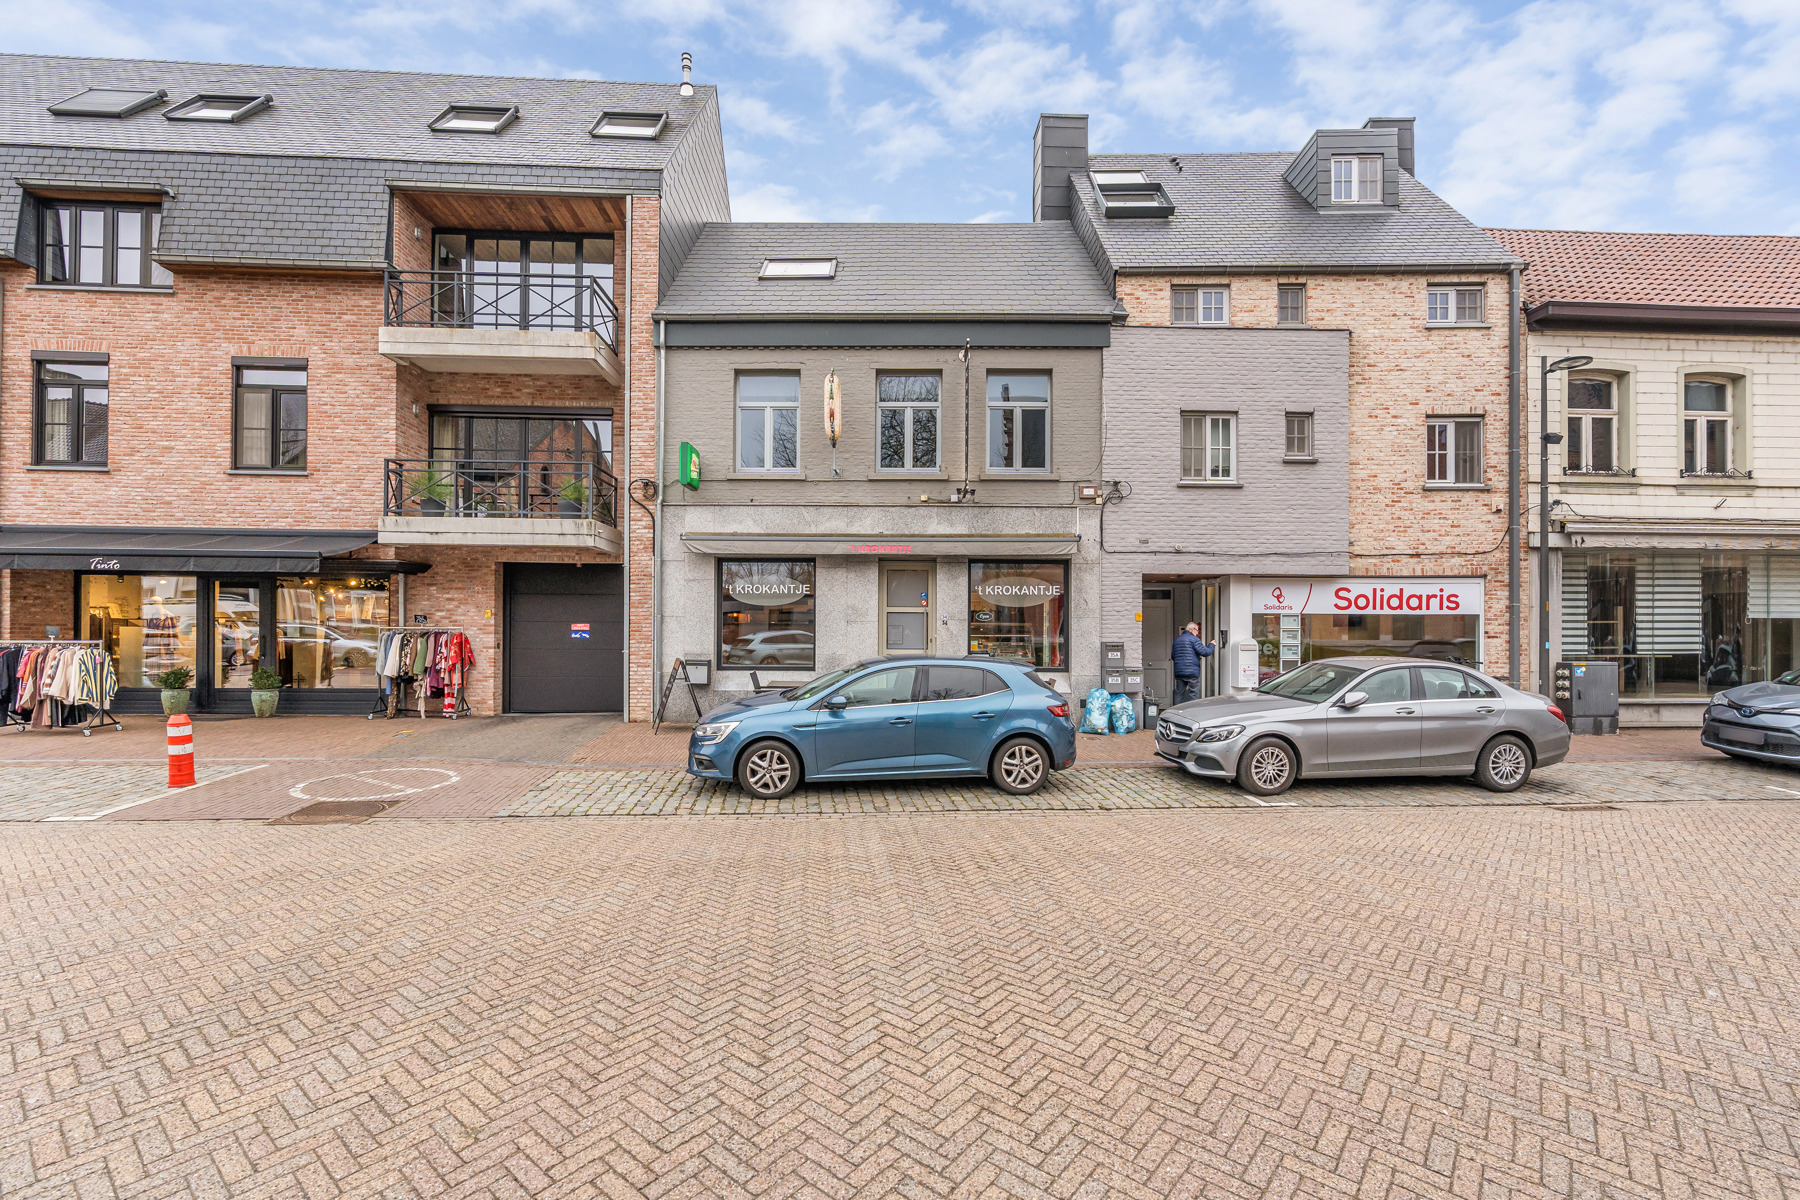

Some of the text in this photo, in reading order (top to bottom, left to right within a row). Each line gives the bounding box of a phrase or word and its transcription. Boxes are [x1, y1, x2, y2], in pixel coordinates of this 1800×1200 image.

[858, 545, 912, 553] KROKANTJE
[90, 557, 120, 570] Tinto
[736, 584, 811, 594] KROKANTJE
[985, 585, 1061, 595] KROKANTJE
[1333, 587, 1460, 611] Solidaris
[1263, 603, 1293, 611] Solidaris
